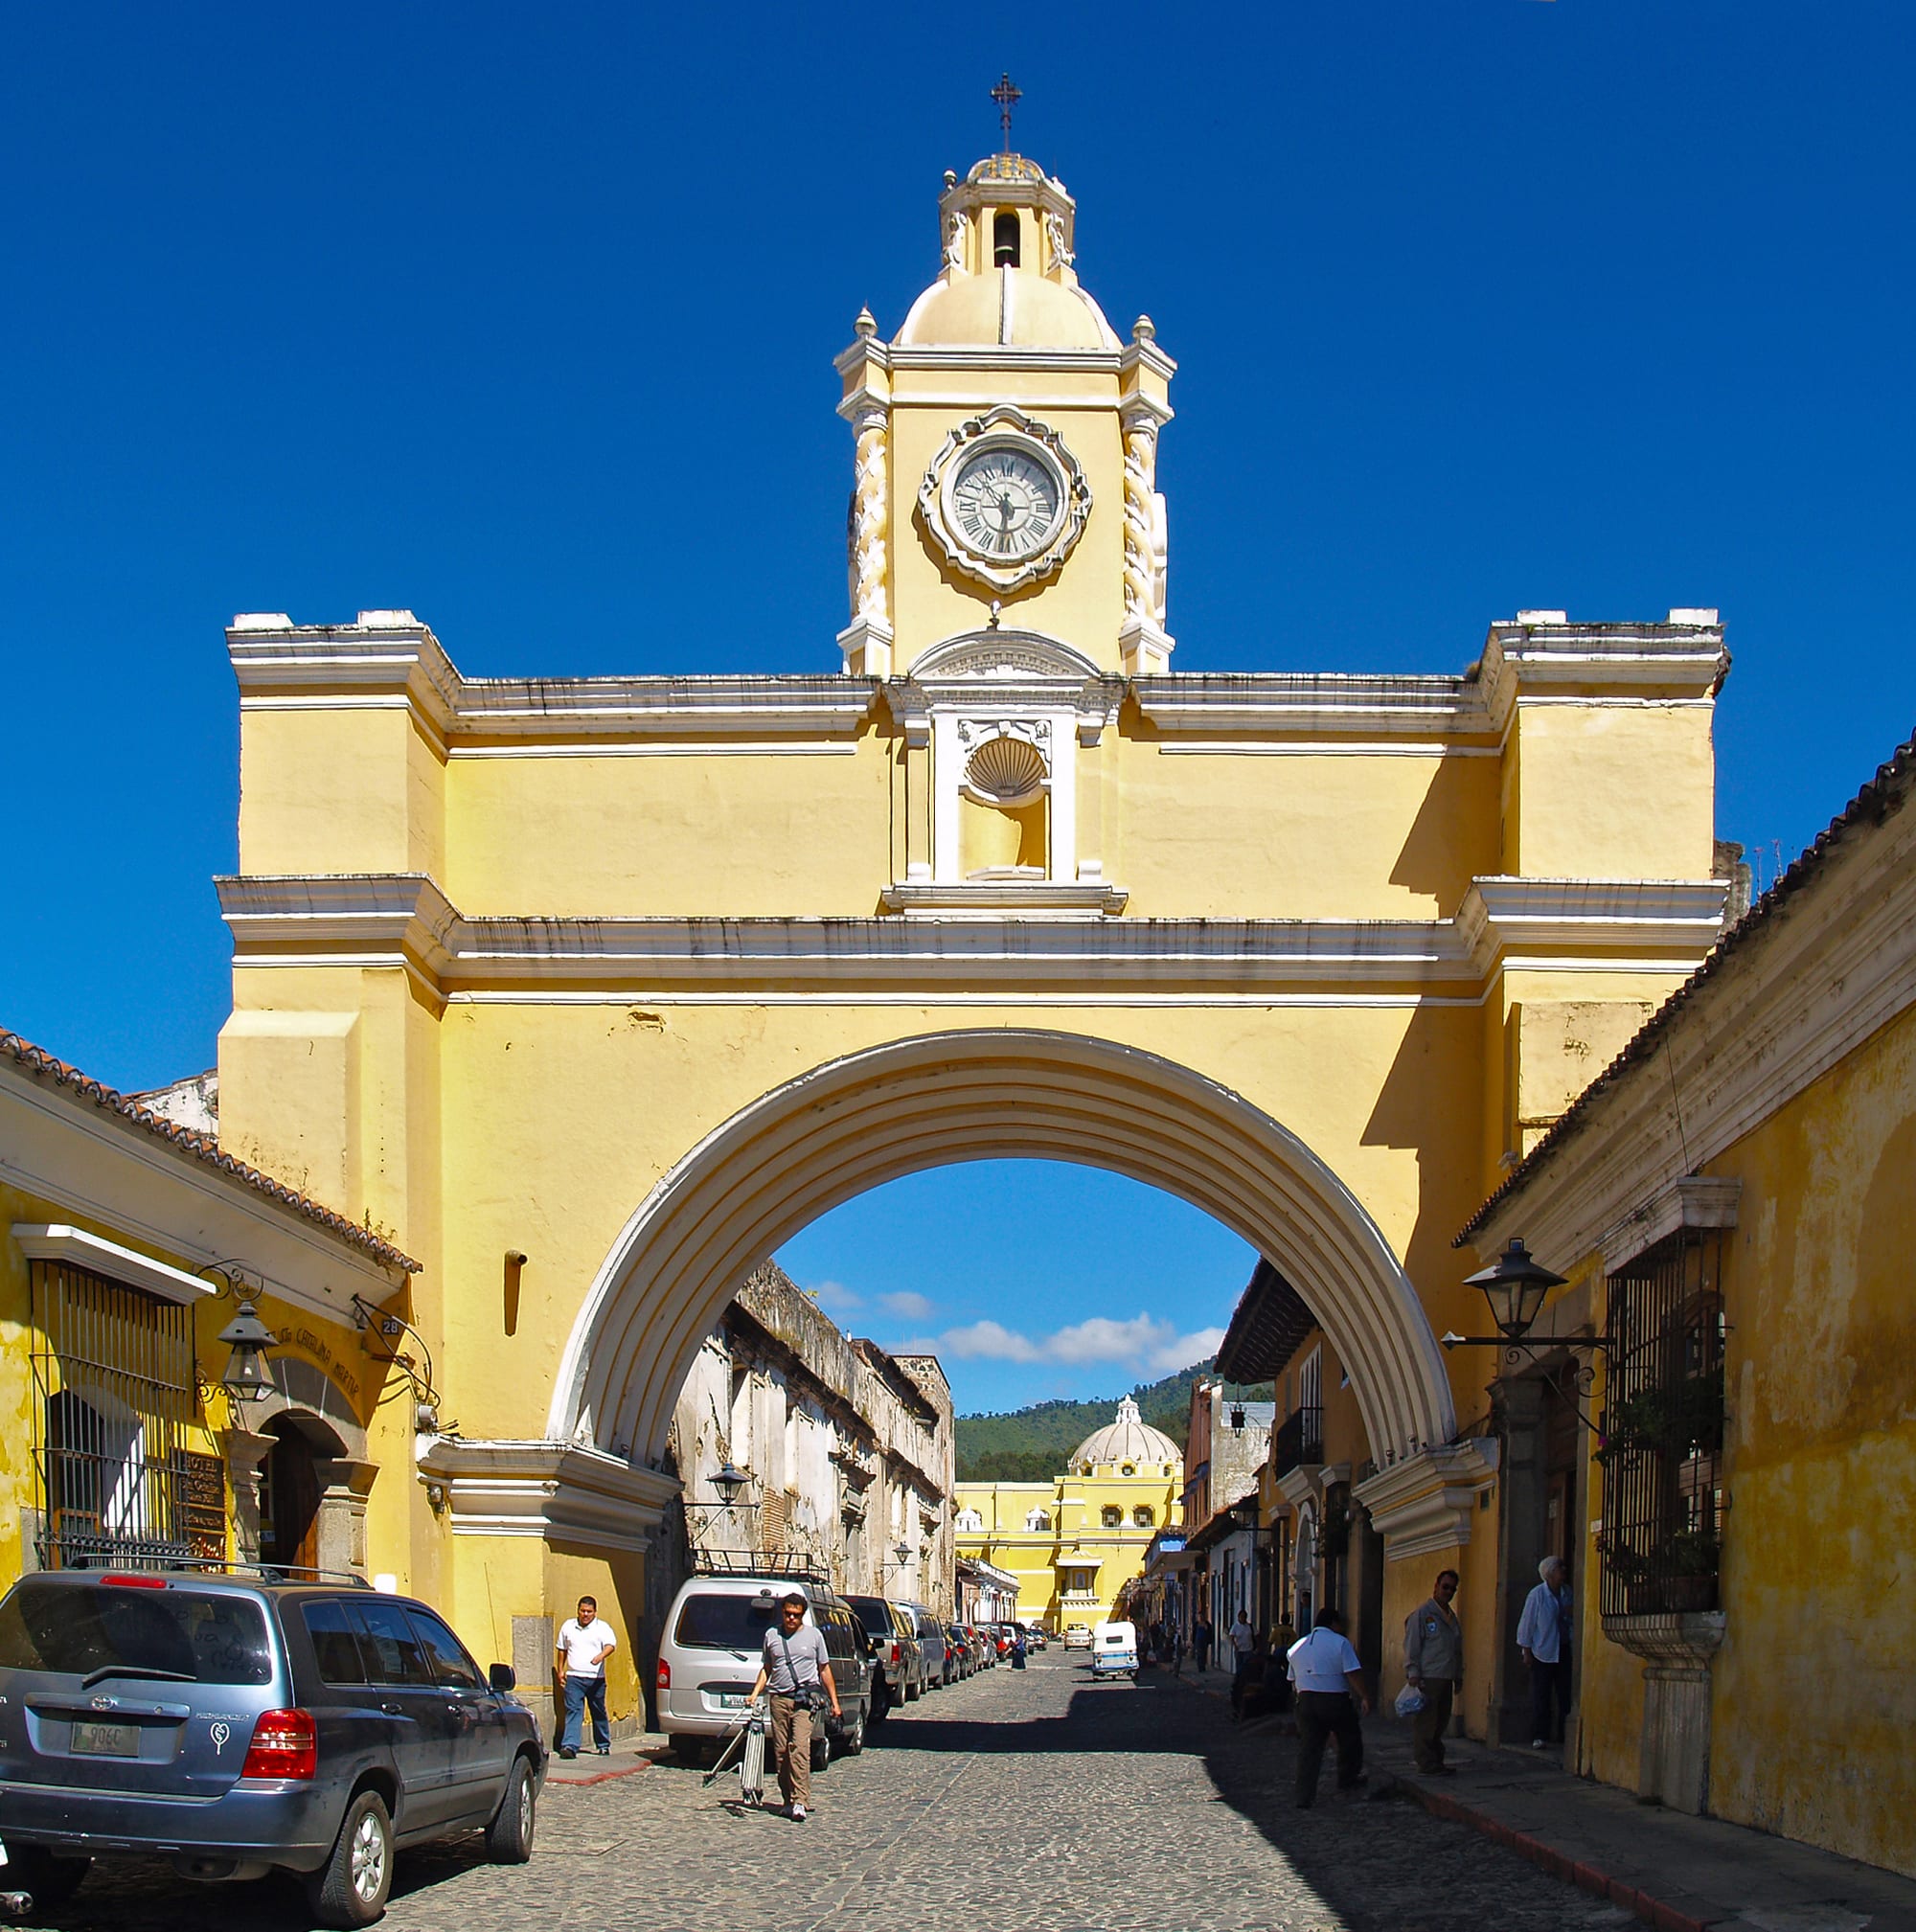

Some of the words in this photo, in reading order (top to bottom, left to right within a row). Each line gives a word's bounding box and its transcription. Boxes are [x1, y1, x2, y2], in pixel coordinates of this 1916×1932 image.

[959, 501, 976, 512] IX
[1036, 503, 1052, 513] III
[383, 1321, 399, 1333] 28
[296, 1328, 331, 1363] CATALINA
